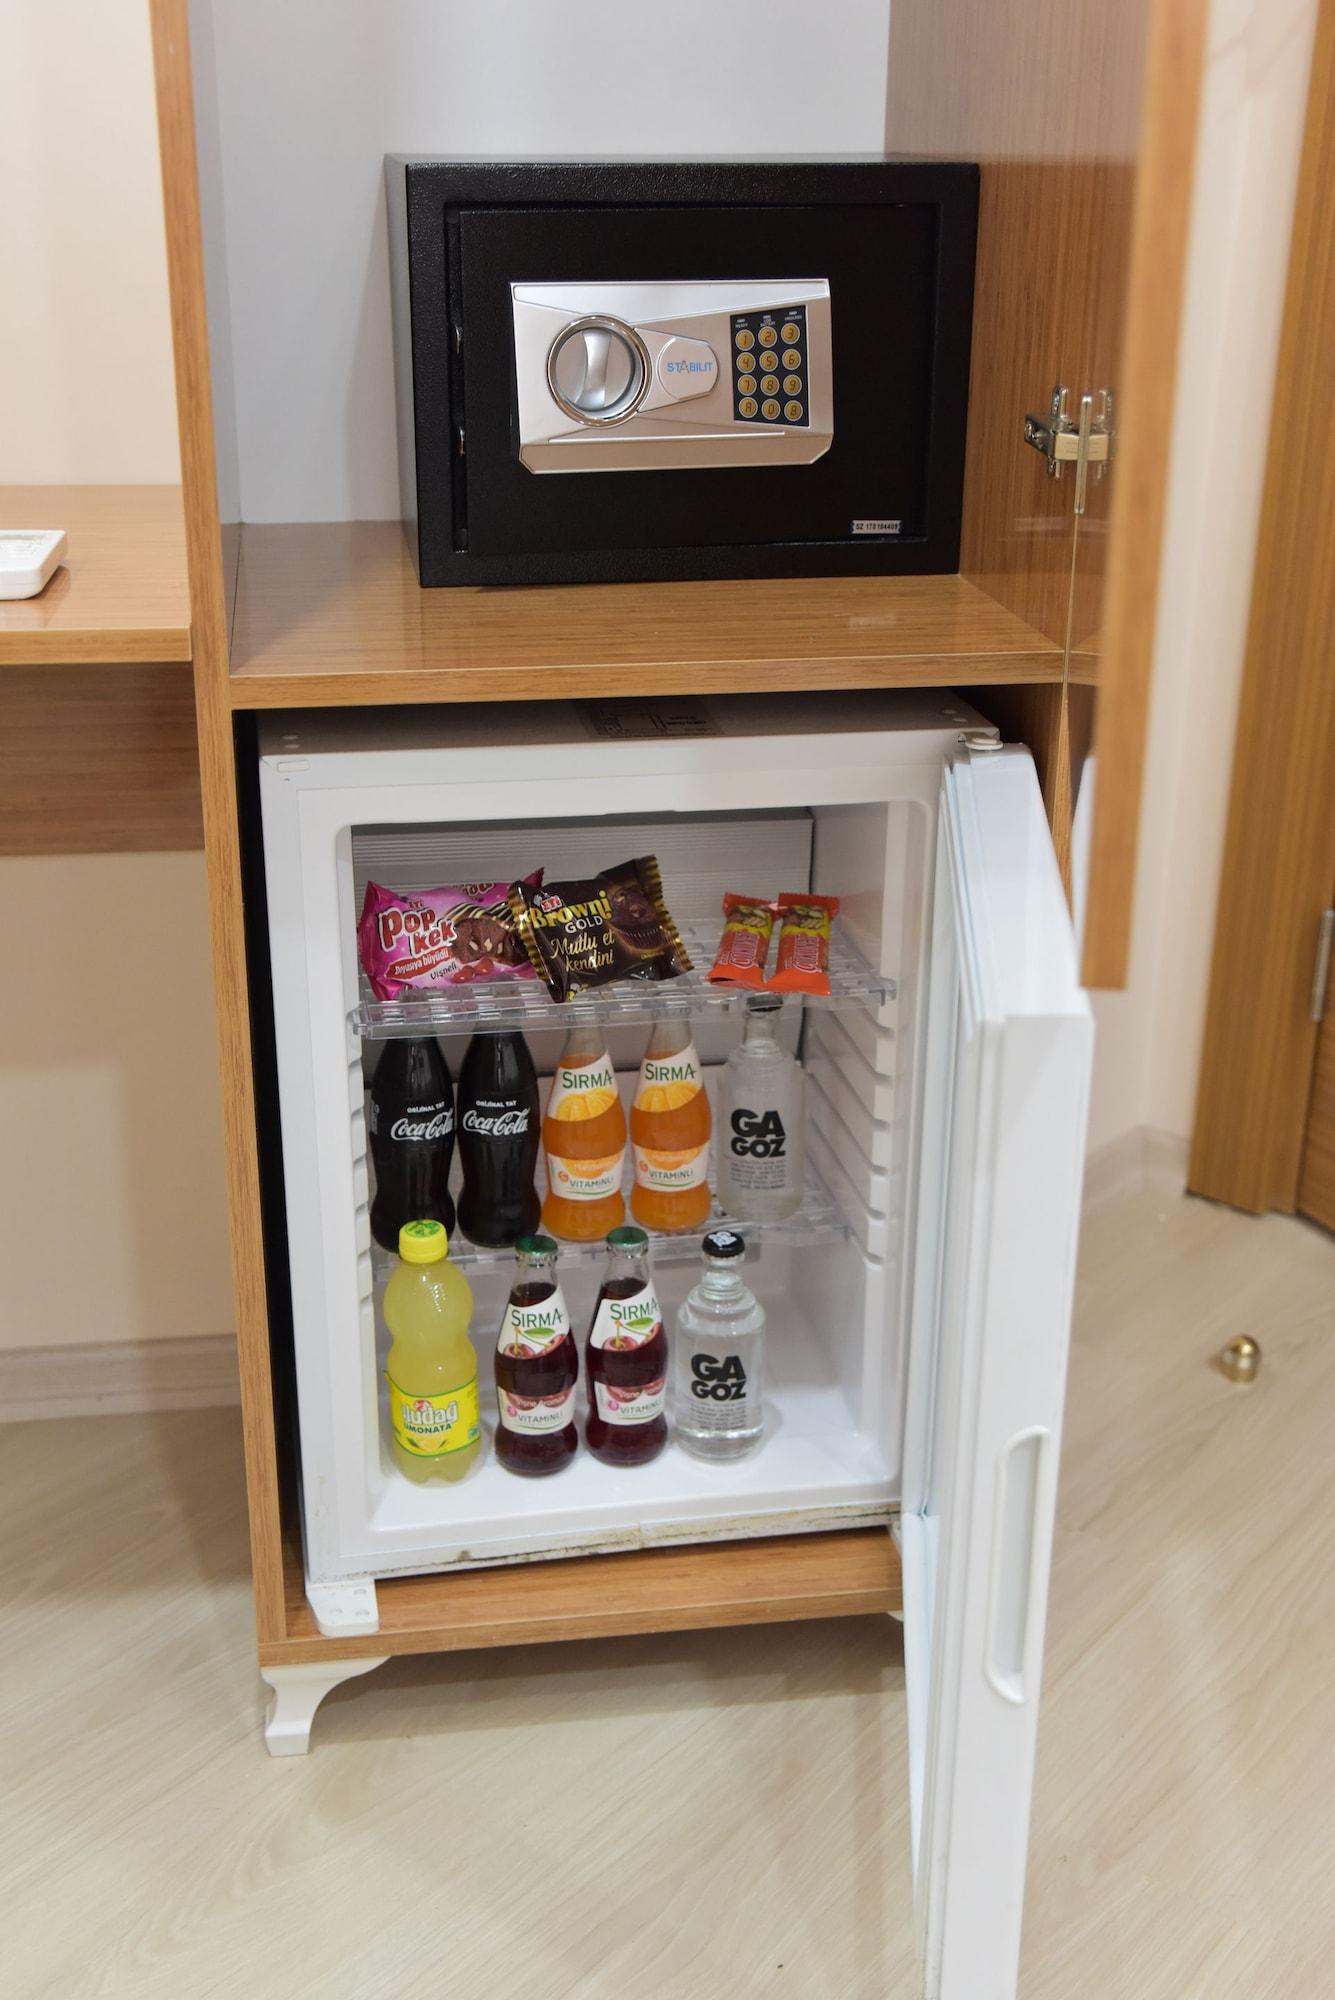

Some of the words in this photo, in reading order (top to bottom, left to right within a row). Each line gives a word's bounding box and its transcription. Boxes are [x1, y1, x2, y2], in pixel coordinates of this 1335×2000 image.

[667, 360, 713, 374] STABILIT
[528, 890, 613, 929] Browni
[564, 915, 604, 934] GOLD
[550, 931, 598, 959] Mutlu
[602, 928, 615, 946] et
[565, 949, 614, 972] kendini
[562, 1069, 613, 1089] SIRMA
[645, 1063, 696, 1081] SIRMA
[463, 1106, 531, 1136] Coca-Cola
[731, 1108, 786, 1138] GA
[731, 1136, 786, 1158] GOZ
[511, 1308, 563, 1329] SIRMA
[610, 1297, 658, 1320] SIRMA
[691, 1354, 747, 1382] GA
[691, 1380, 747, 1401] GOZ
